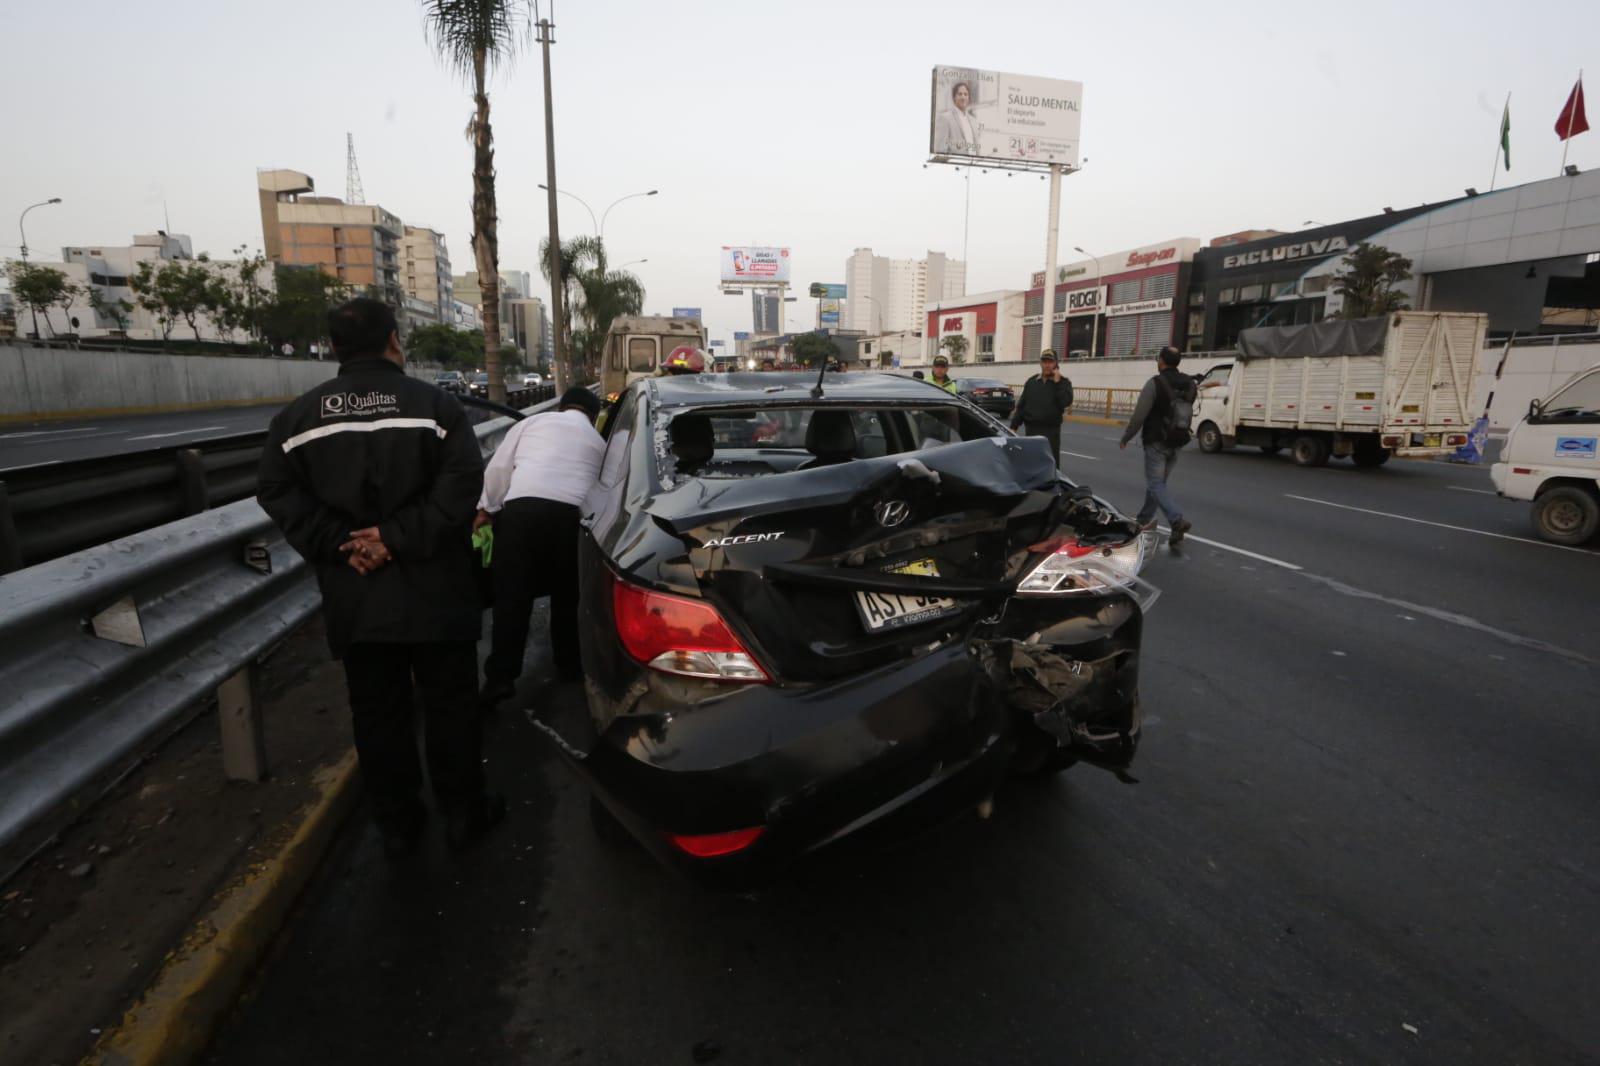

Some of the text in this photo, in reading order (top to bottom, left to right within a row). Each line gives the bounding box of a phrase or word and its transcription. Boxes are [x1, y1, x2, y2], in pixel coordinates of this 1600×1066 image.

[1008, 94, 1079, 112] SALUD MENTAL
[1011, 138, 1021, 149] 21
[1126, 247, 1176, 268] Snap-on
[1223, 236, 1348, 269] EXCLUCIVA
[347, 391, 397, 410] Quálitas
[702, 531, 785, 549] ACCENT
